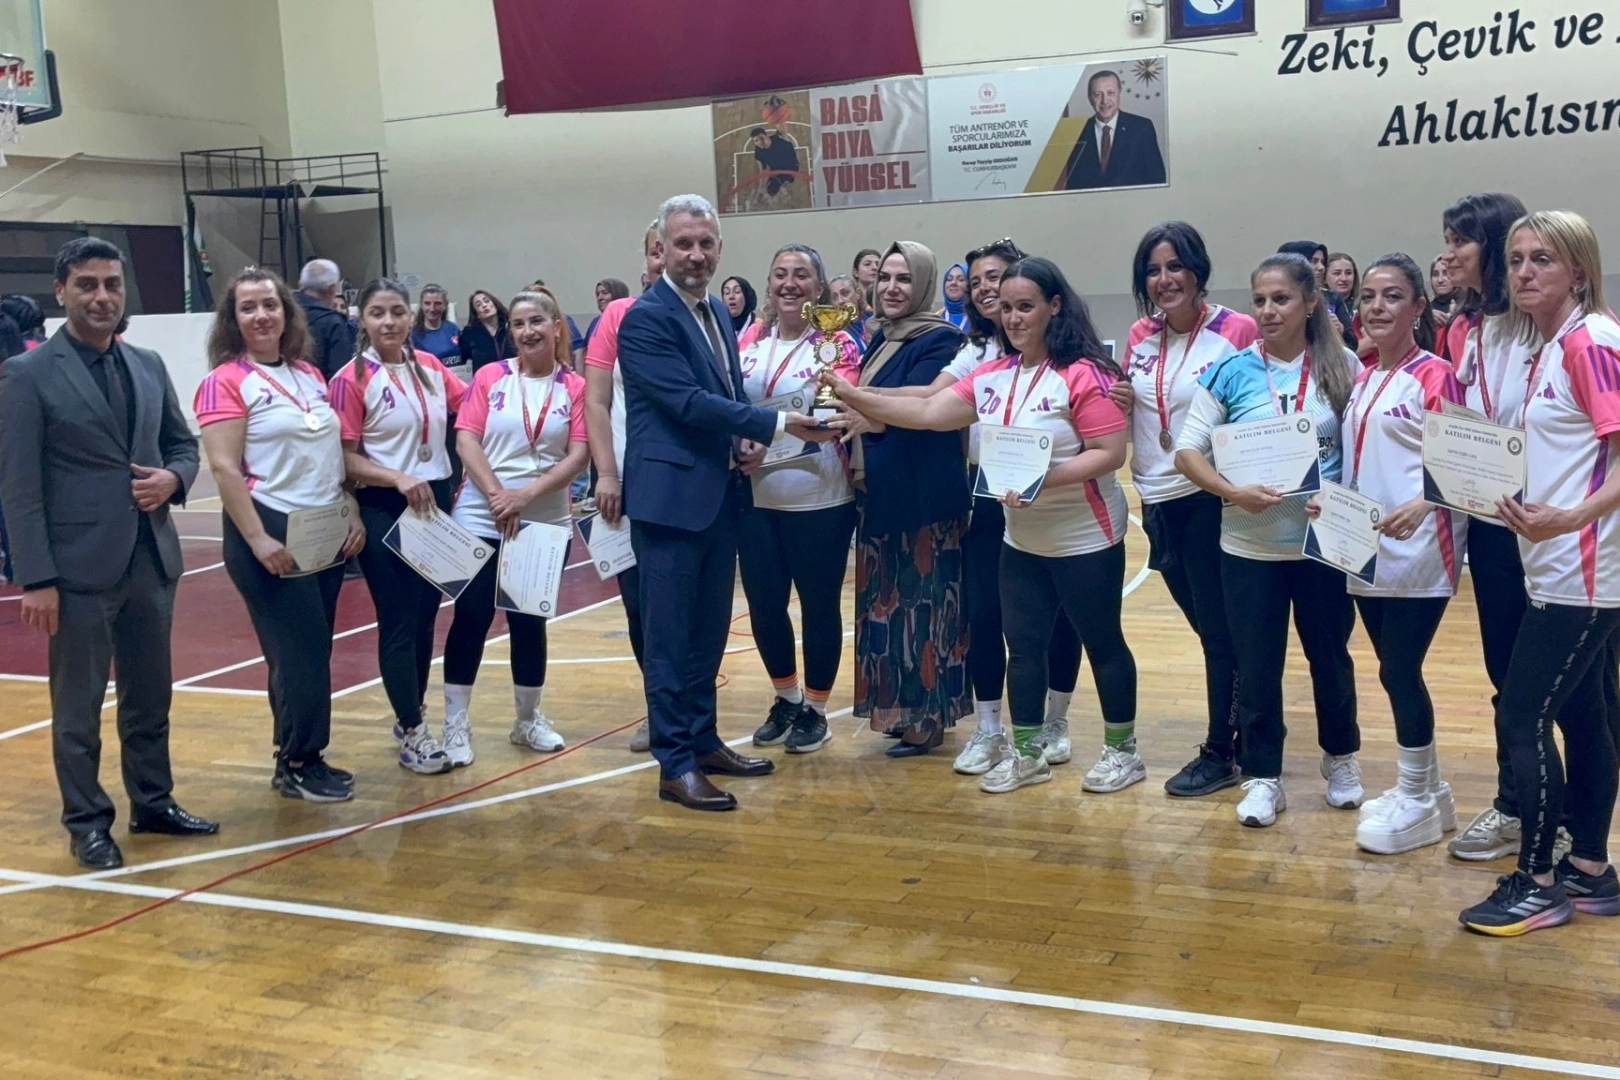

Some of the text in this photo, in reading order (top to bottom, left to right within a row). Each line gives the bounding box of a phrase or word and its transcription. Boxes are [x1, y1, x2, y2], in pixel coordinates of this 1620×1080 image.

[1278, 9, 1604, 78] Zeki, Çevik ve
[949, 119, 1029, 134] TÜM ANTRENÖR VE
[952, 129, 1027, 143] SPORCULARIMIZA
[948, 139, 1031, 153] BAŞARILAR DİLİYORUM
[382, 386, 396, 409] 9
[979, 387, 1002, 415] 20
